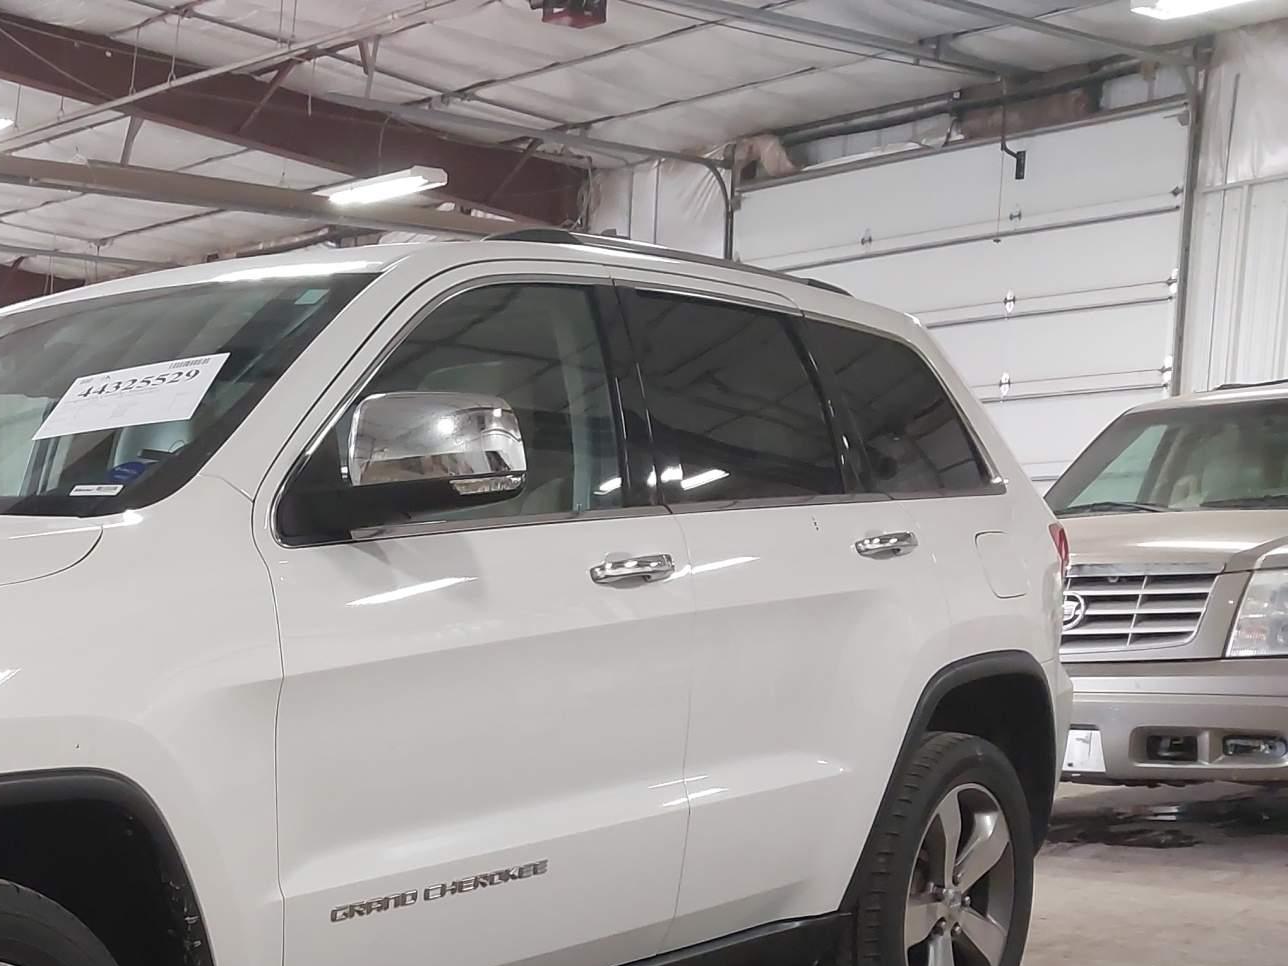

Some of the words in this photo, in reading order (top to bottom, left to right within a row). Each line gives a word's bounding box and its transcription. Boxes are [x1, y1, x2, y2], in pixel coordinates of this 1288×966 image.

[78, 369, 200, 397] 44325529
[330, 889, 418, 922] GRAND
[423, 859, 549, 902] CHEROKEE
